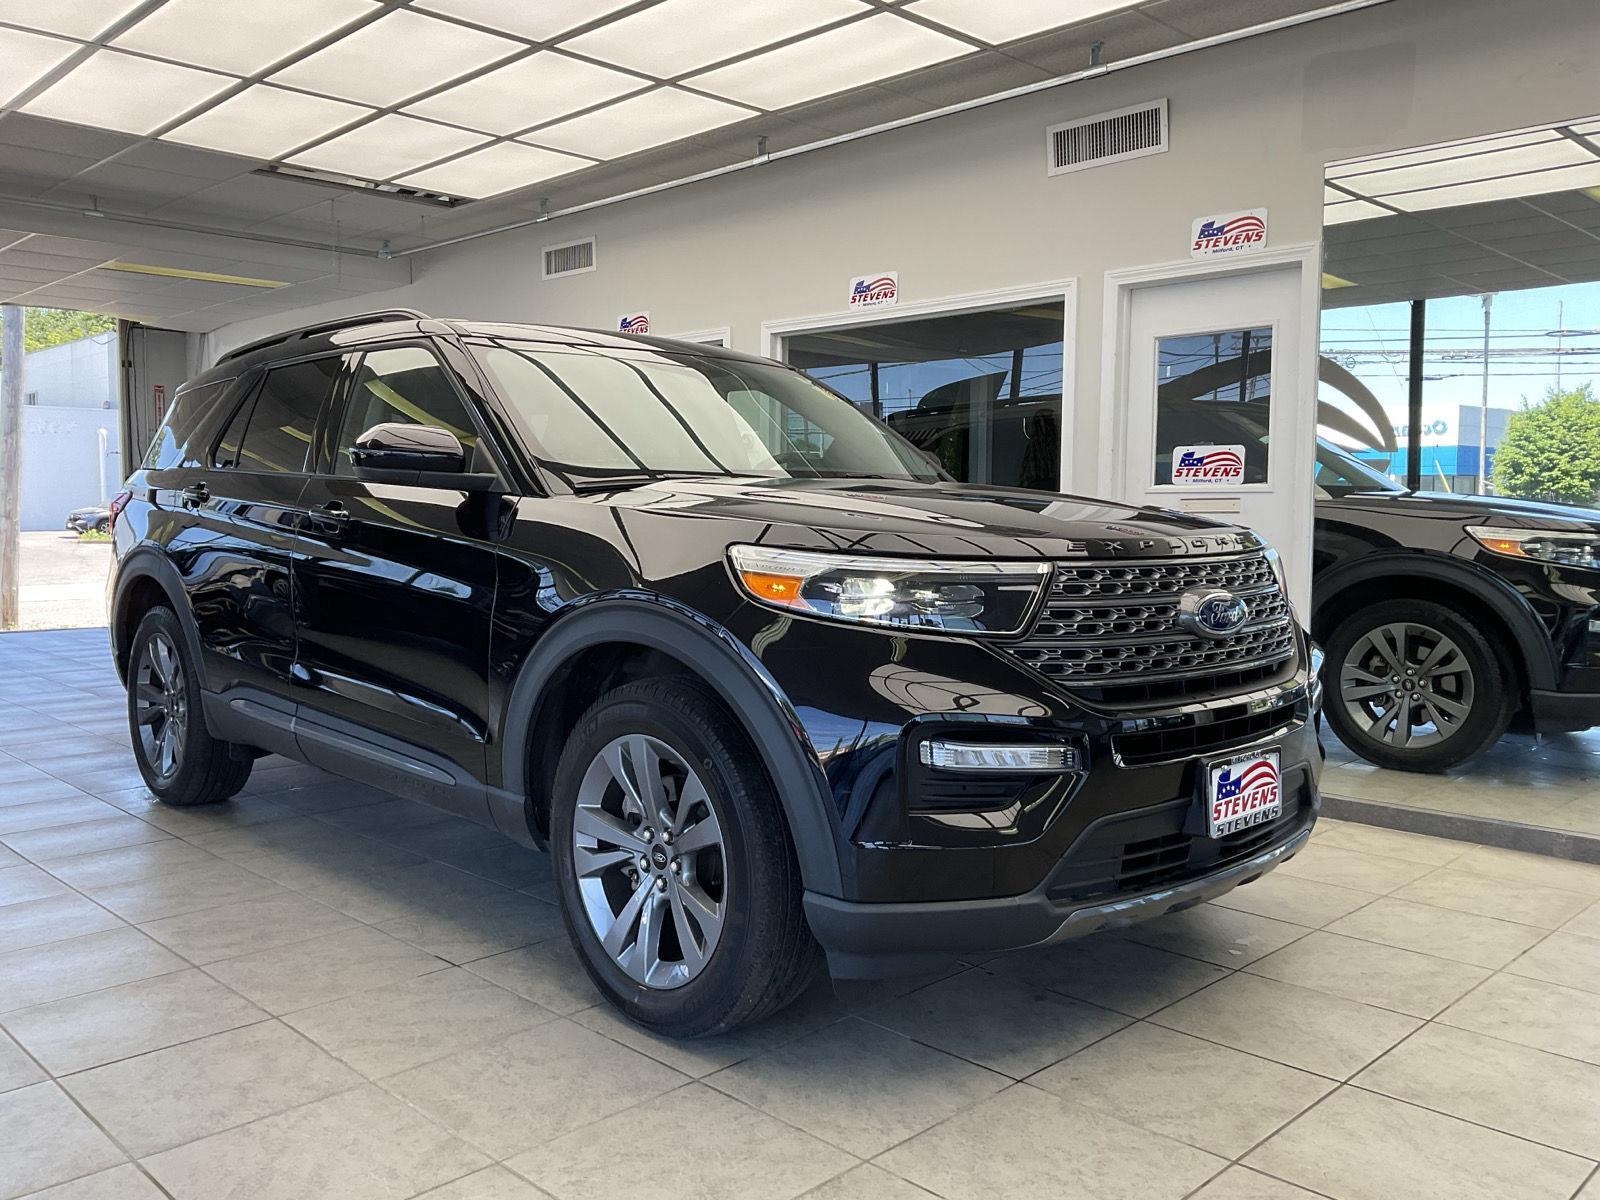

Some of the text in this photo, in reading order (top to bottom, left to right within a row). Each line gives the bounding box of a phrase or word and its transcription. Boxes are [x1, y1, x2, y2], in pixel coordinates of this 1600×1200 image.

[1193, 231, 1264, 250] STEVENS
[851, 290, 895, 303] STEVENS
[1174, 467, 1242, 477] STEVENS
[1210, 600, 1240, 625] Ford
[1213, 786, 1278, 821] STEVENS
[1216, 806, 1279, 836] STEVENS
